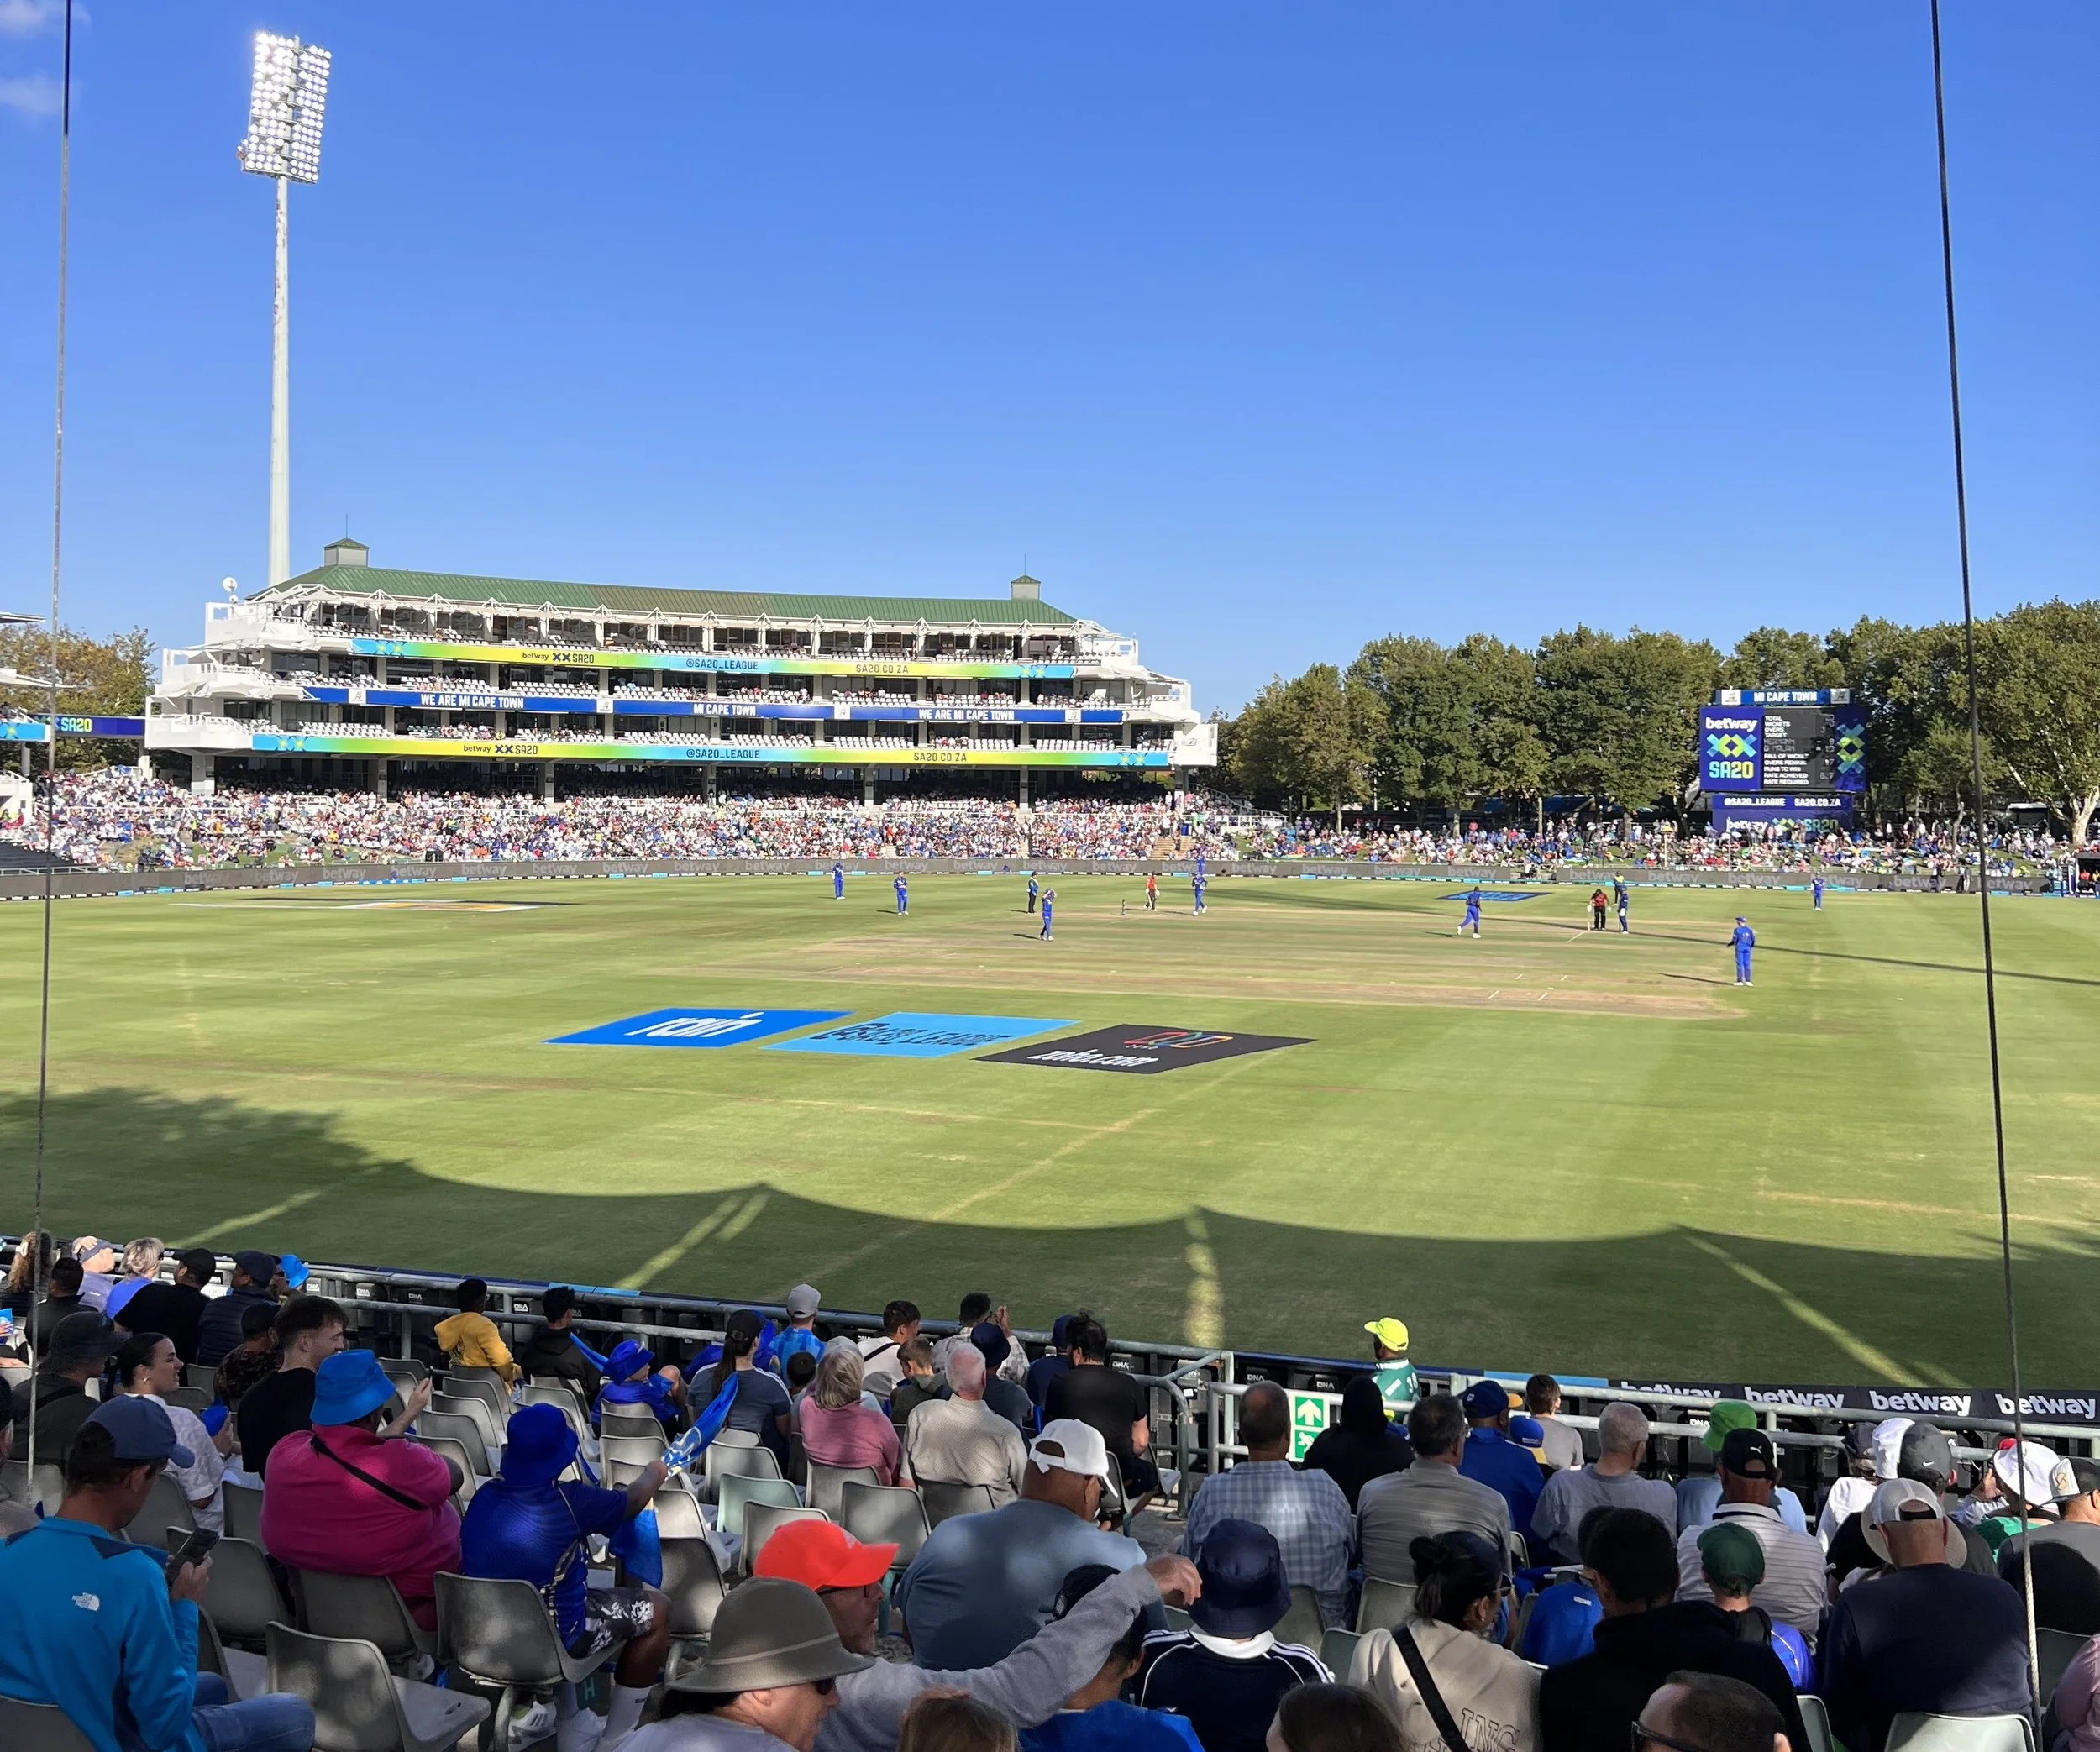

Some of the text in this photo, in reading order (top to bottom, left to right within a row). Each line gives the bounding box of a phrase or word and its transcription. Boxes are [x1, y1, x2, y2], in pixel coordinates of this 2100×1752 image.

[522, 652, 595, 664] betway SA20
[685, 658, 759, 670] @SA20_LEAGUE
[421, 693, 524, 709] WE ARE MI CAPE TOWN
[1754, 691, 1817, 702] MI CAPE TOWN
[694, 703, 756, 717] MI CAPE TOWN
[918, 708, 1014, 721] WE ARE MI CAPE TOWN
[60, 717, 92, 732] SA20
[1705, 716, 1759, 732] betway
[463, 744, 538, 755] betway SA20
[685, 747, 760, 760] @SA20_LEAGUE
[1709, 760, 1754, 779] SA20
[1316, 1380, 1335, 1390] DNA
[1869, 1390, 1971, 1417] betway
[1994, 1393, 2096, 1419] betway
